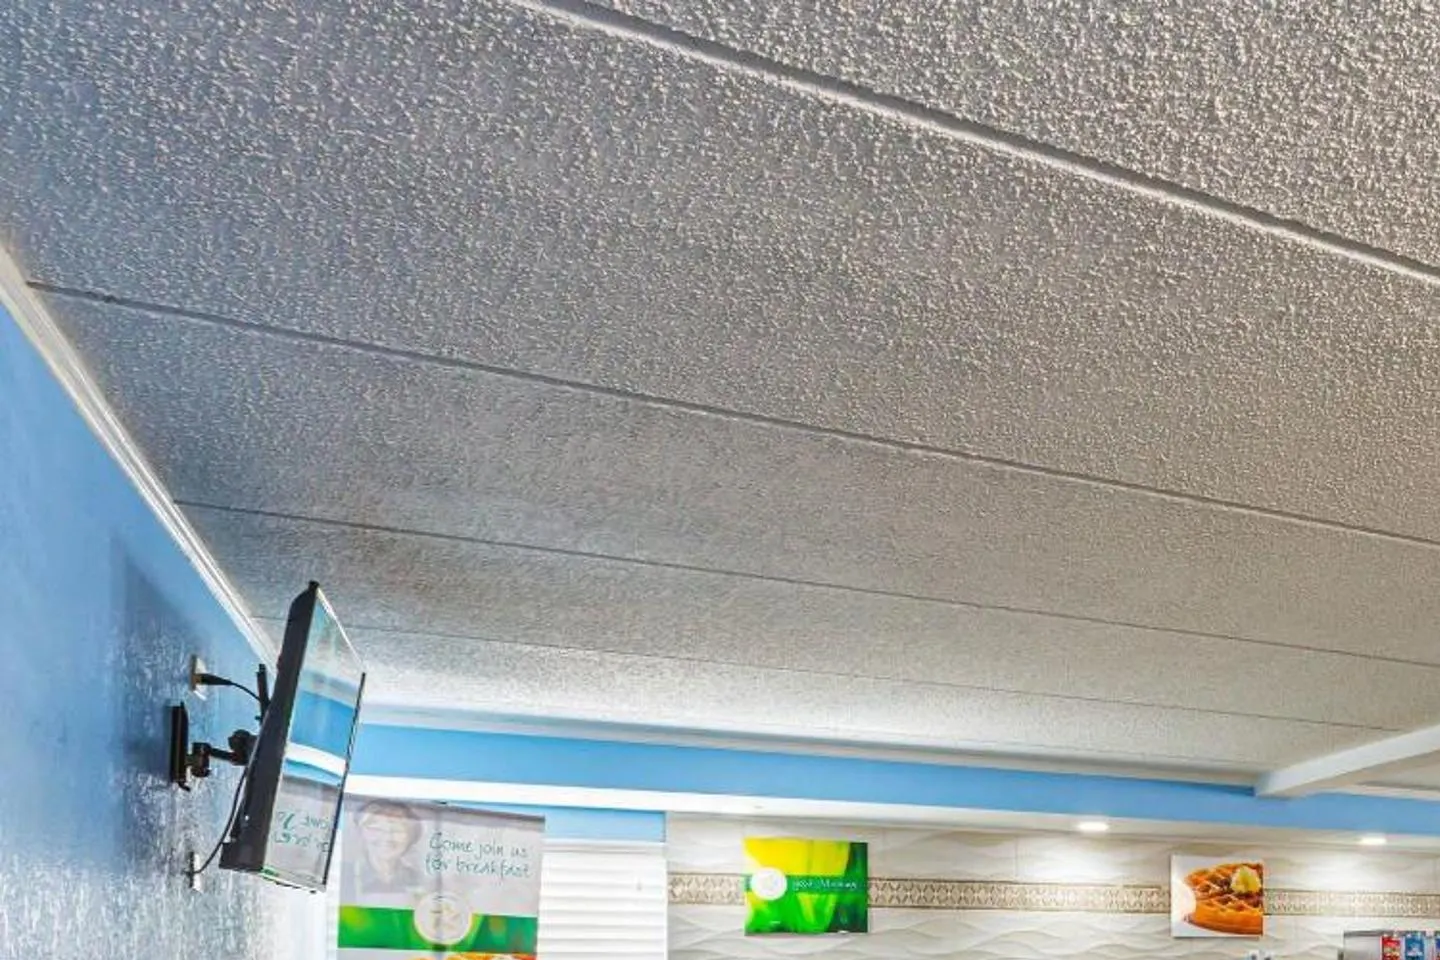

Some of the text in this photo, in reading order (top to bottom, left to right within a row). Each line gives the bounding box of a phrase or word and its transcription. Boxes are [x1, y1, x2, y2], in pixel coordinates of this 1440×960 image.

[429, 832, 528, 860] Come join us
[456, 855, 533, 879] breakfast
